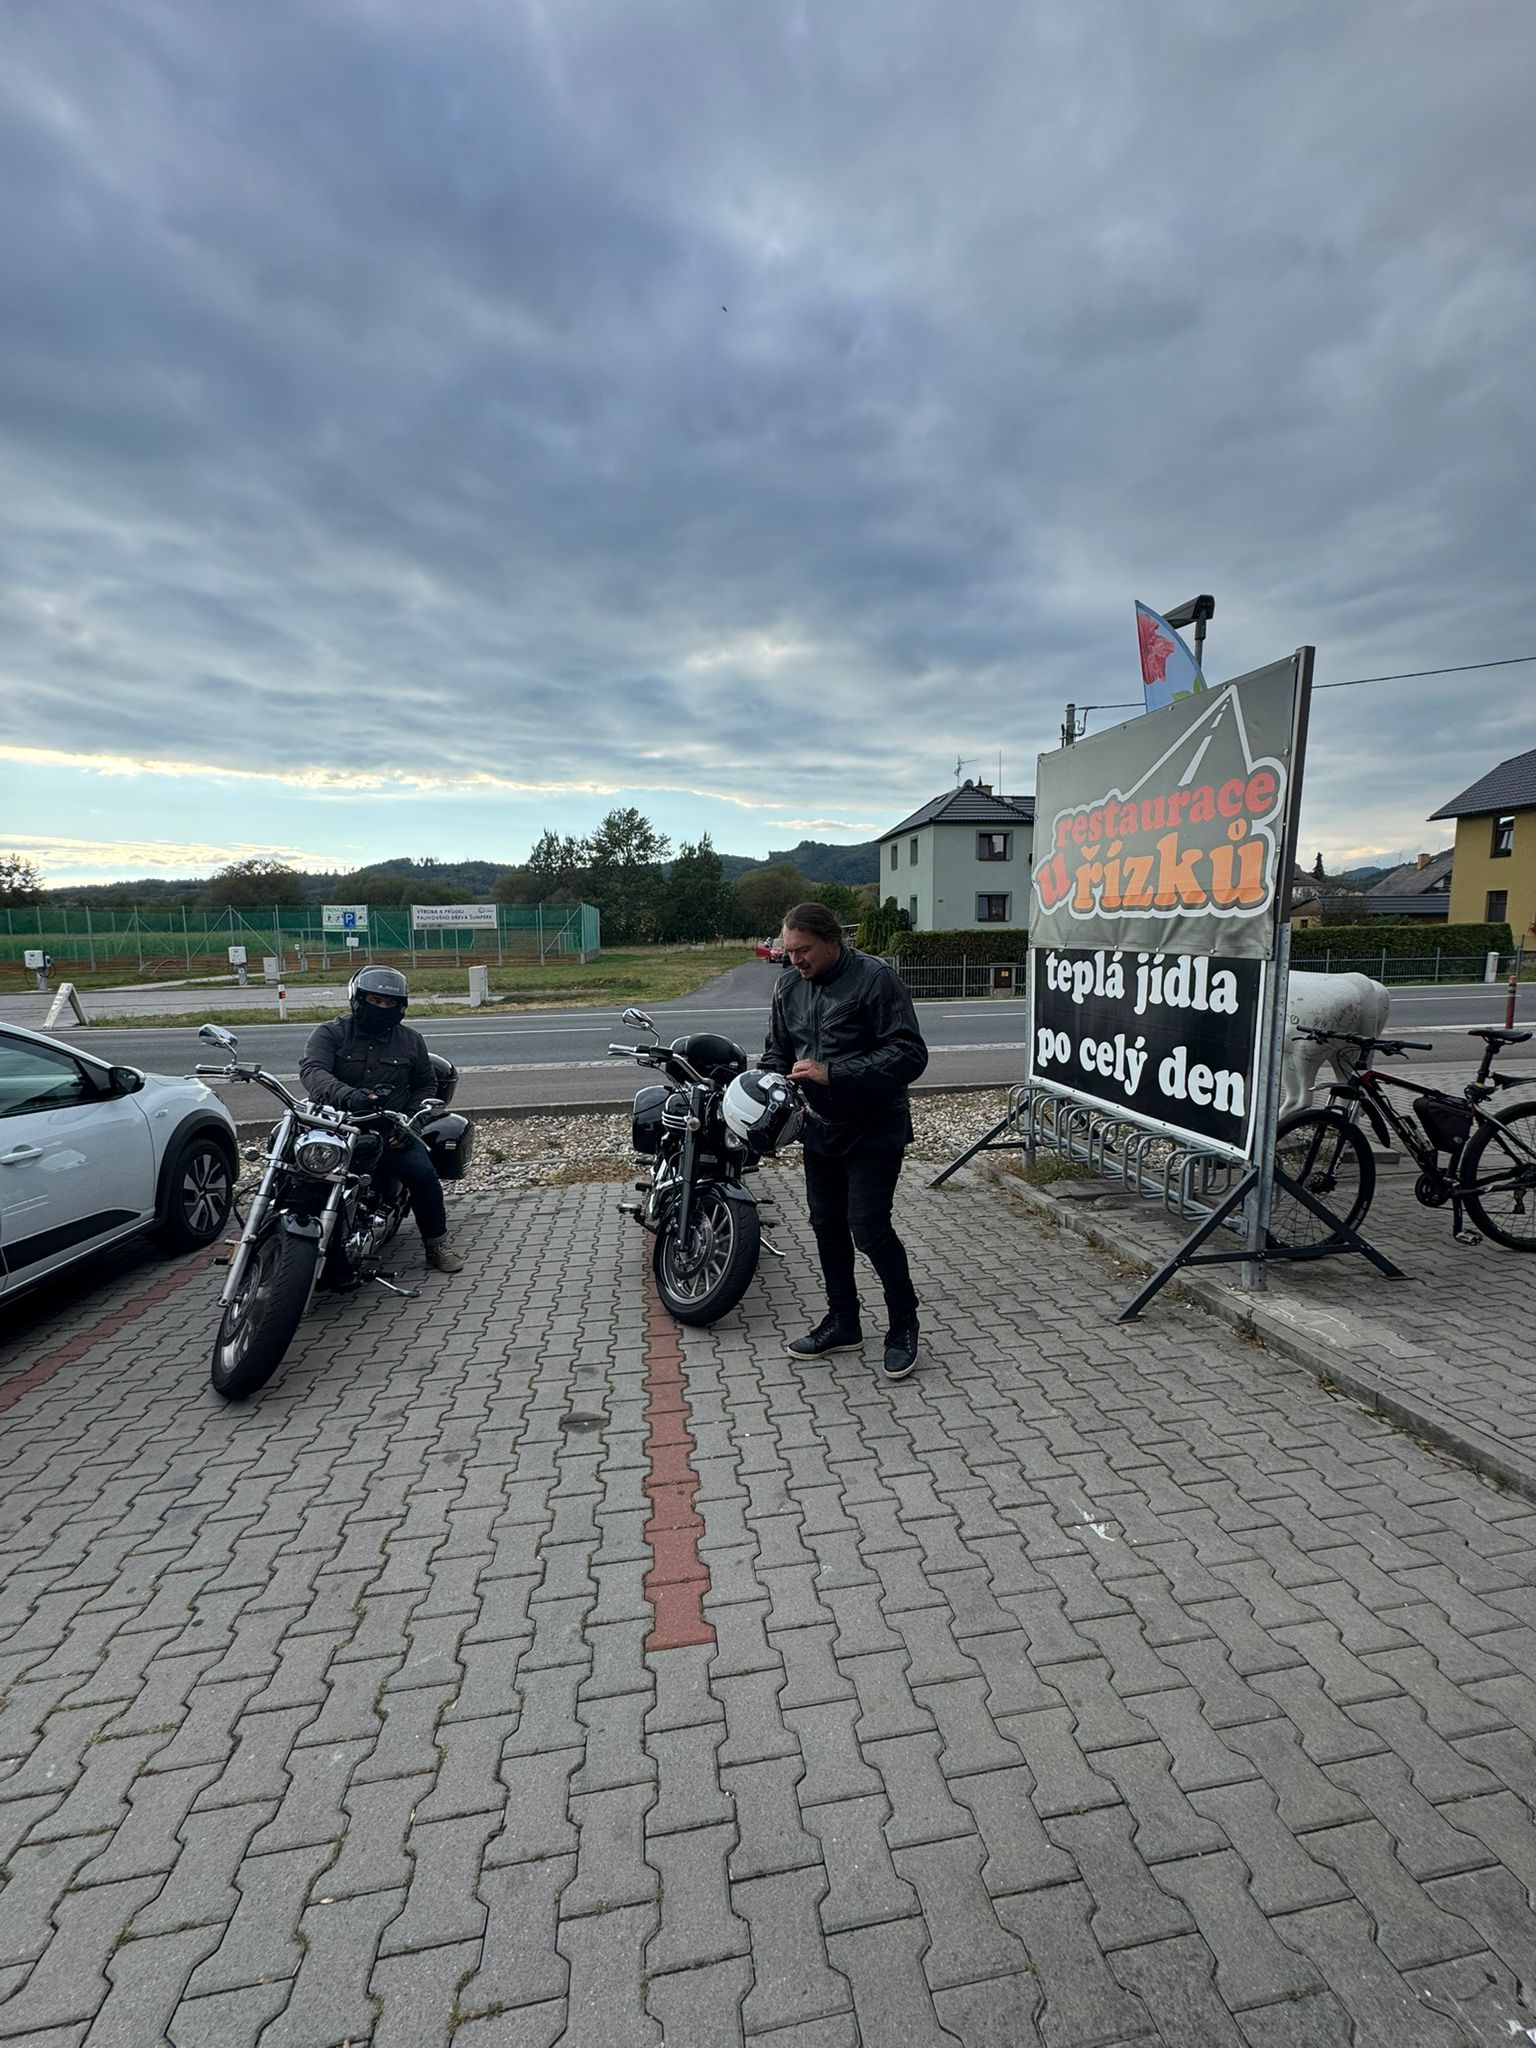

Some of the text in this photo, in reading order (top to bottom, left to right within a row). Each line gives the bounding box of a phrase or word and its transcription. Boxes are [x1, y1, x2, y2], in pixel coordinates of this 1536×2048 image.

[1056, 772, 1276, 848] restaurace
[1036, 818, 1265, 910] u řízků
[345, 913, 354, 924] P
[1046, 950, 1239, 1015] teplá jídla
[1037, 1027, 1245, 1117] po celý den
